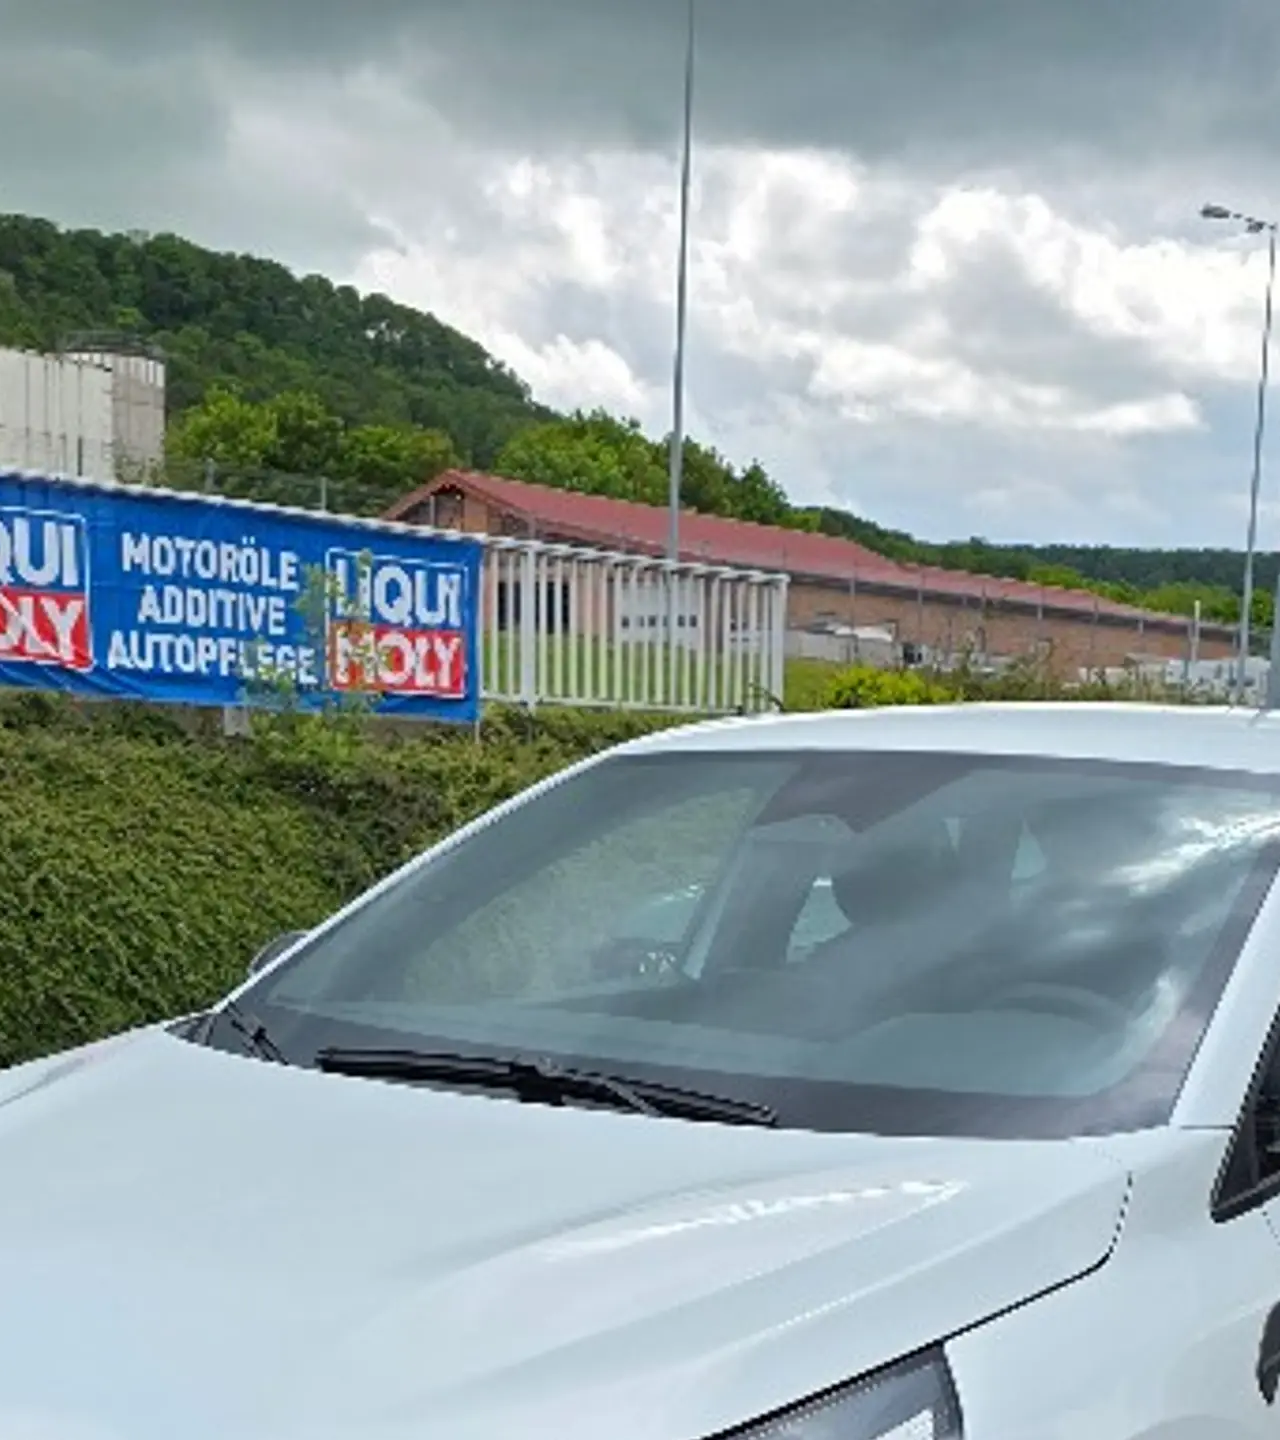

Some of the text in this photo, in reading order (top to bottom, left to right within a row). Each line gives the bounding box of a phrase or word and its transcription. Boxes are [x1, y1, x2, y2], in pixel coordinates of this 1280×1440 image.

[121, 531, 300, 592] MOTORÖLE
[137, 584, 287, 636] ADDITIVE
[107, 629, 319, 685] AUTOPFLEGE
